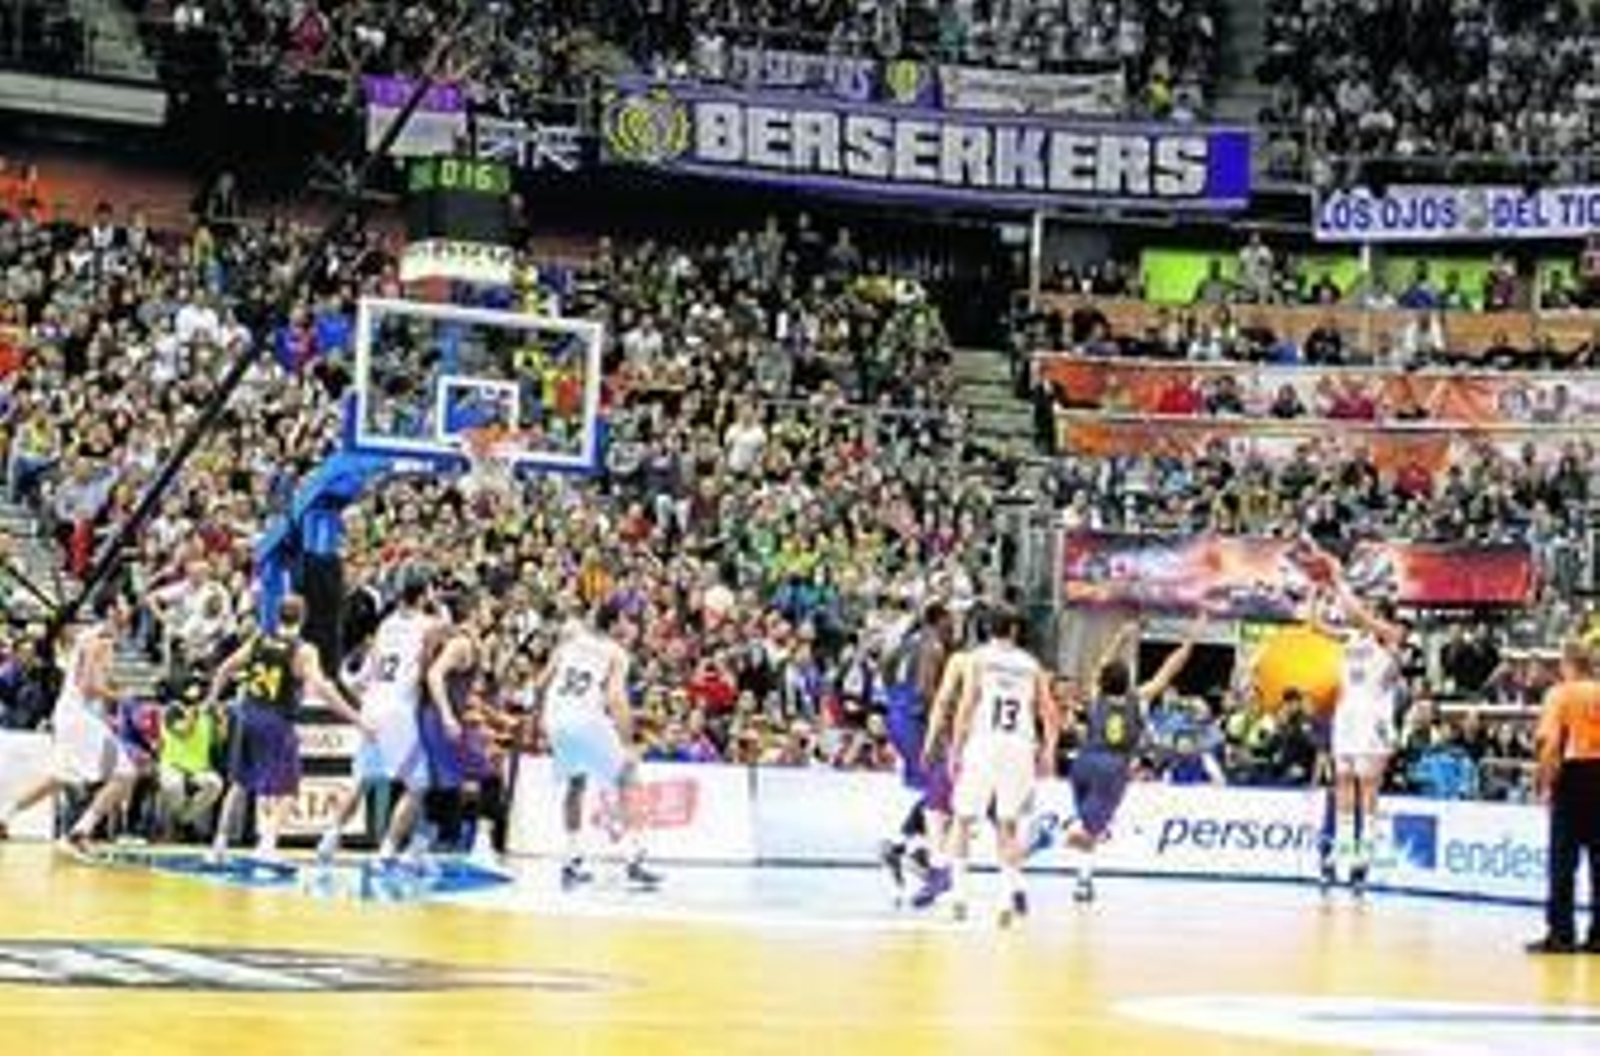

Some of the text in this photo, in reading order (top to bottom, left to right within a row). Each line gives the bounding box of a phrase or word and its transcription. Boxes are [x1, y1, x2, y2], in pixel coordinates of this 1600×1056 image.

[694, 101, 1208, 197] BERSERKERS
[1319, 194, 1375, 232] LOS
[1384, 196, 1463, 231] OJOS
[1498, 193, 1558, 230] DEL
[992, 696, 1021, 731] 13
